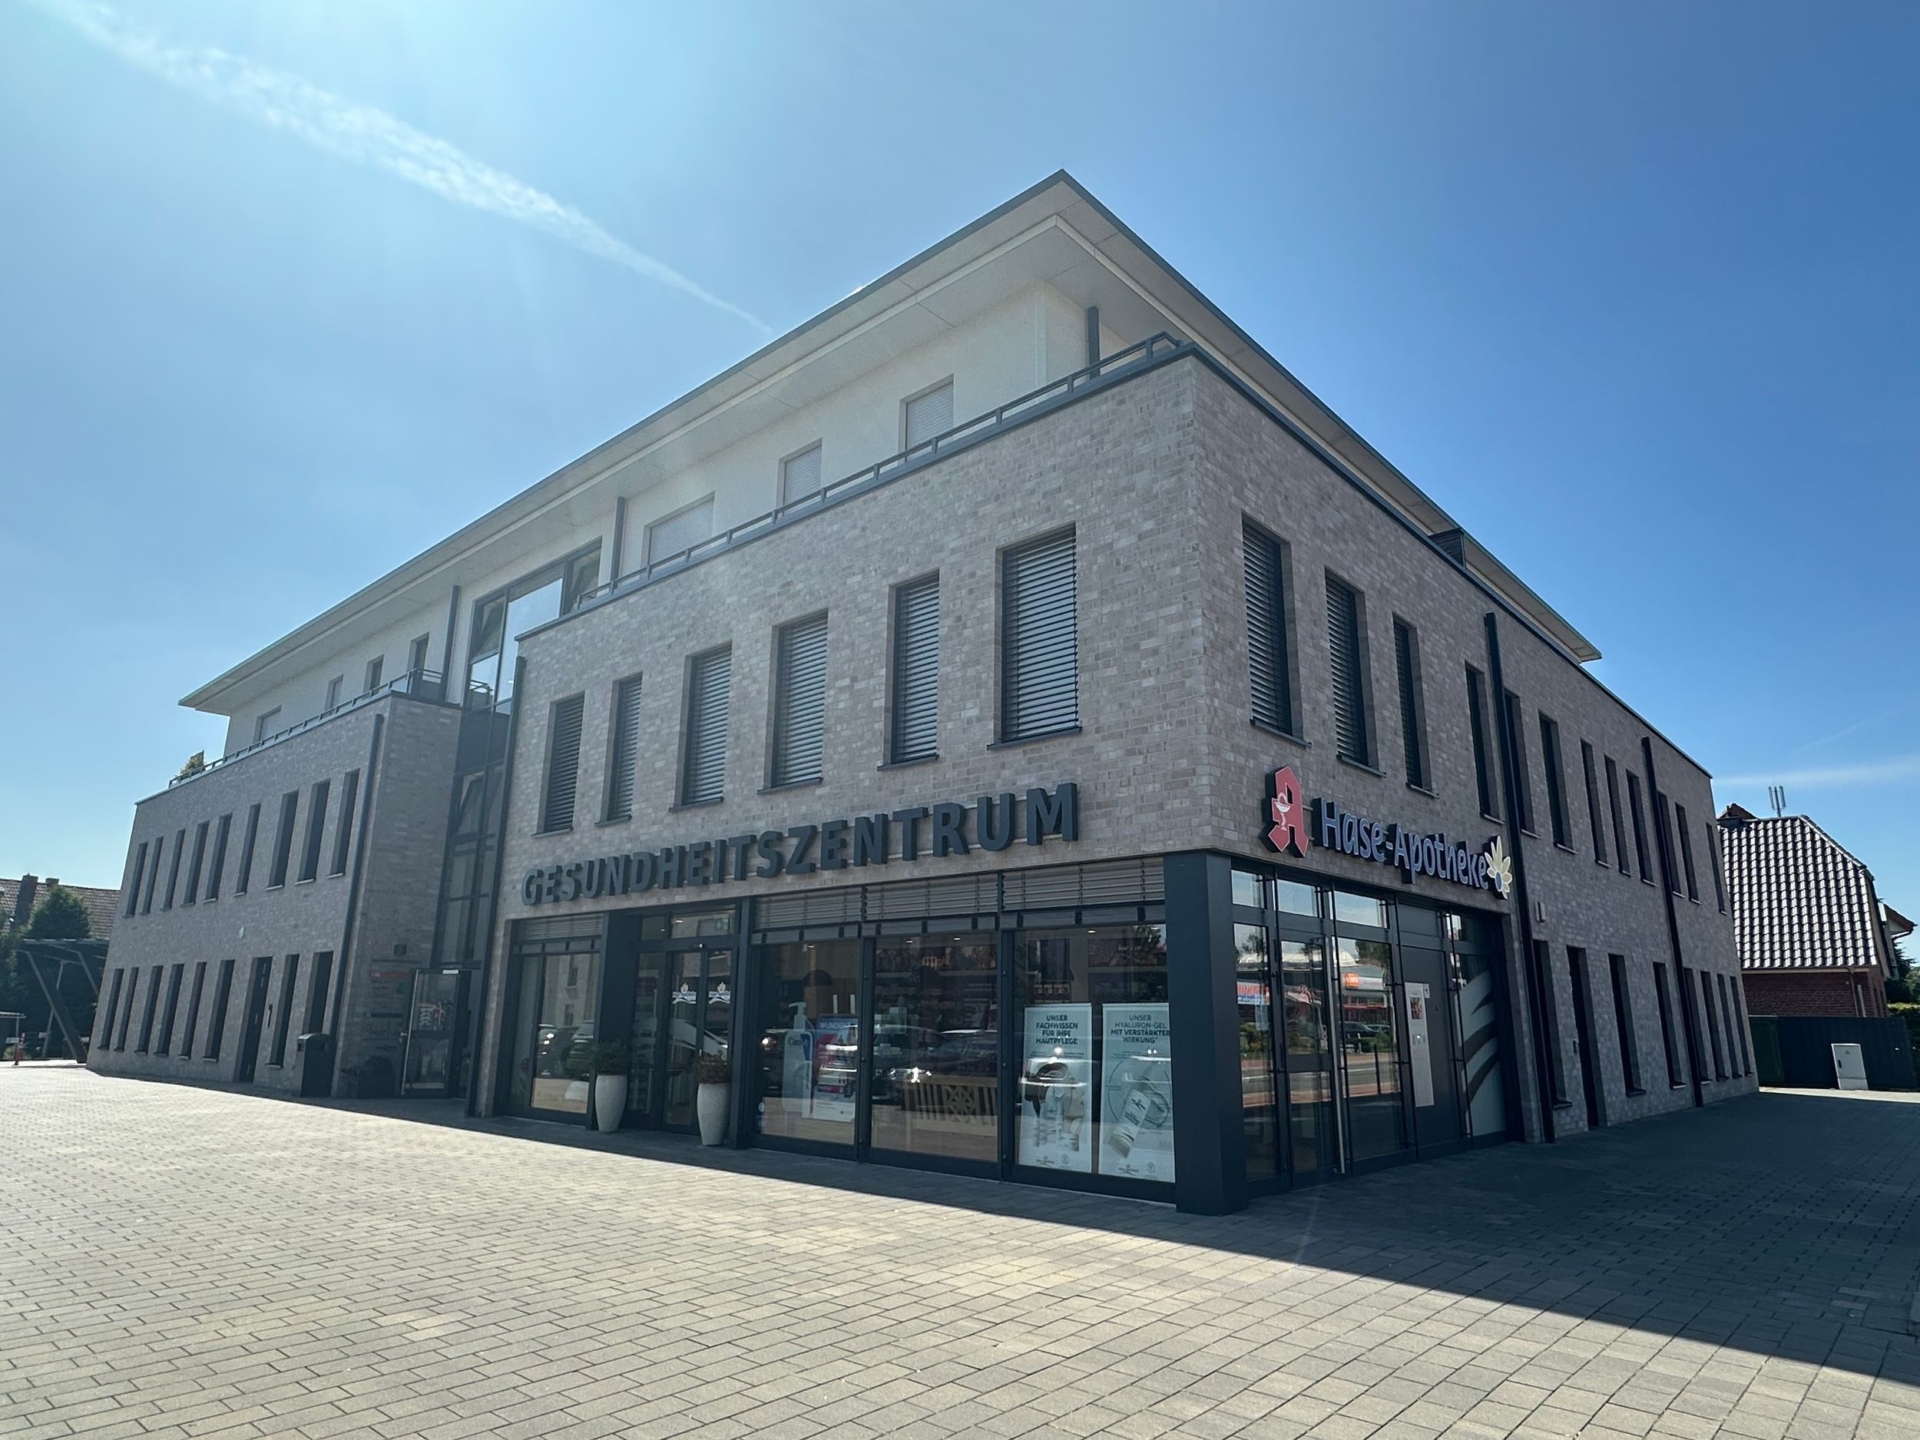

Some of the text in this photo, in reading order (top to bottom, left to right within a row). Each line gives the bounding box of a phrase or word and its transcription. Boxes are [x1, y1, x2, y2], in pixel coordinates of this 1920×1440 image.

[521, 782, 1078, 906] GESUNDHEITSZENTRUM
[1318, 797, 1489, 891] Hase-Apotheke
[1046, 1014, 1068, 1022] UNSER
[1128, 1014, 1152, 1022] UNSER
[1036, 1022, 1079, 1030] FACHWISSEN
[1114, 1021, 1167, 1029] HYALURON-GEL
[1036, 1037, 1078, 1045] HAUTPFLEGE
